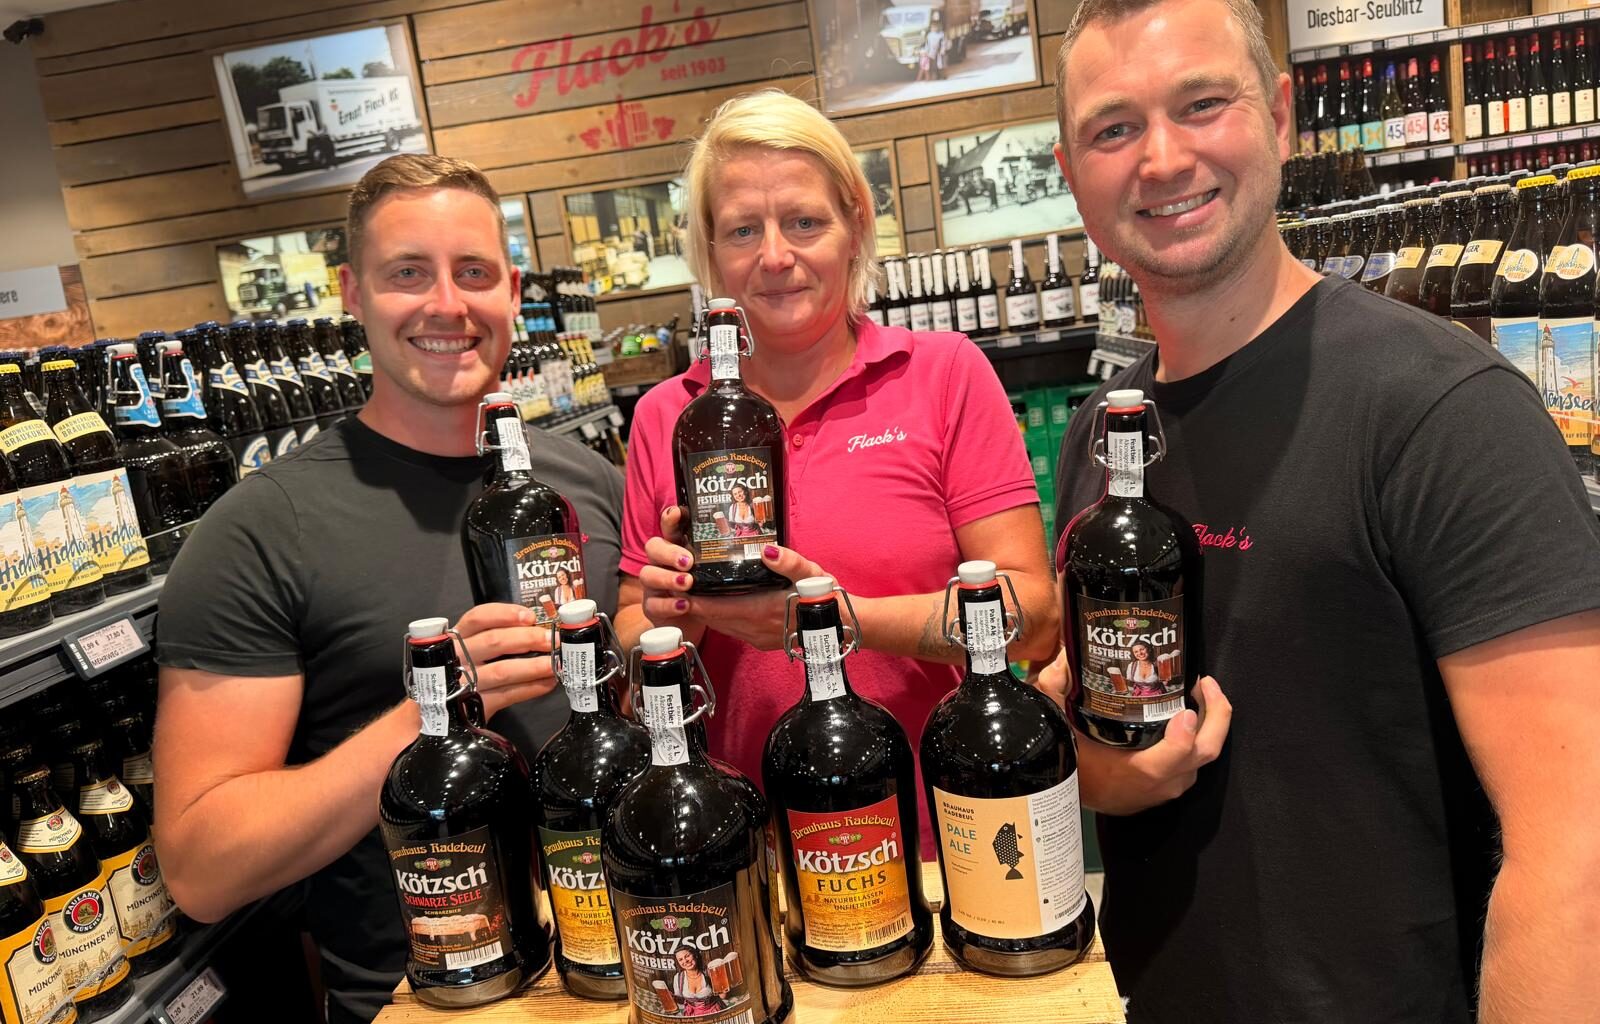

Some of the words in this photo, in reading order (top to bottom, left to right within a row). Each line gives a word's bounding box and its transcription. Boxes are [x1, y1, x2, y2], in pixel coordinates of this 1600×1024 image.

[1307, 0, 1423, 28] Diesbar-Seußlitz
[511, 0, 722, 108] Flack's
[660, 69, 687, 81] seit
[692, 56, 726, 77] 1903
[847, 425, 908, 453] Flack's
[692, 454, 728, 474] Brauhaus
[730, 453, 767, 470] Radebeul
[694, 472, 768, 494] Kötzsch
[697, 493, 732, 505] FESTBIER
[520, 577, 557, 590] FESTBIER
[1084, 608, 1130, 620] Brauhaus
[1131, 607, 1178, 622] Radebeul
[823, 634, 831, 652] Fuchs
[1086, 623, 1177, 648] Kötzsch
[92, 650, 119, 665] MEHRWEG
[1088, 644, 1132, 660] FESTBIER
[666, 694, 674, 724] Festbier
[942, 801, 975, 814] BRAUHAUS
[943, 808, 974, 821] RADEBEUL
[791, 819, 841, 840] Brauhaus
[843, 815, 896, 827] Radebeul
[947, 823, 977, 840] PALE
[430, 842, 487, 855] Radebeul
[543, 838, 584, 856] Brauhaus
[797, 837, 899, 874] Kötzsch
[949, 839, 972, 855] ALE
[396, 865, 488, 895] Kötzsch
[816, 870, 888, 893] FUCHS
[65, 891, 100, 915] PAULANER
[824, 890, 884, 904] NATURBELASSEN
[834, 898, 880, 911] UNFILTRIERT
[620, 904, 666, 920] Brauhaus
[668, 902, 727, 917] Radebeul
[73, 913, 102, 932] MÜNCHEN
[58, 935, 106, 959] MÜNCHNER
[625, 923, 730, 955] Kötzsch
[630, 950, 676, 970] FESTBIER
